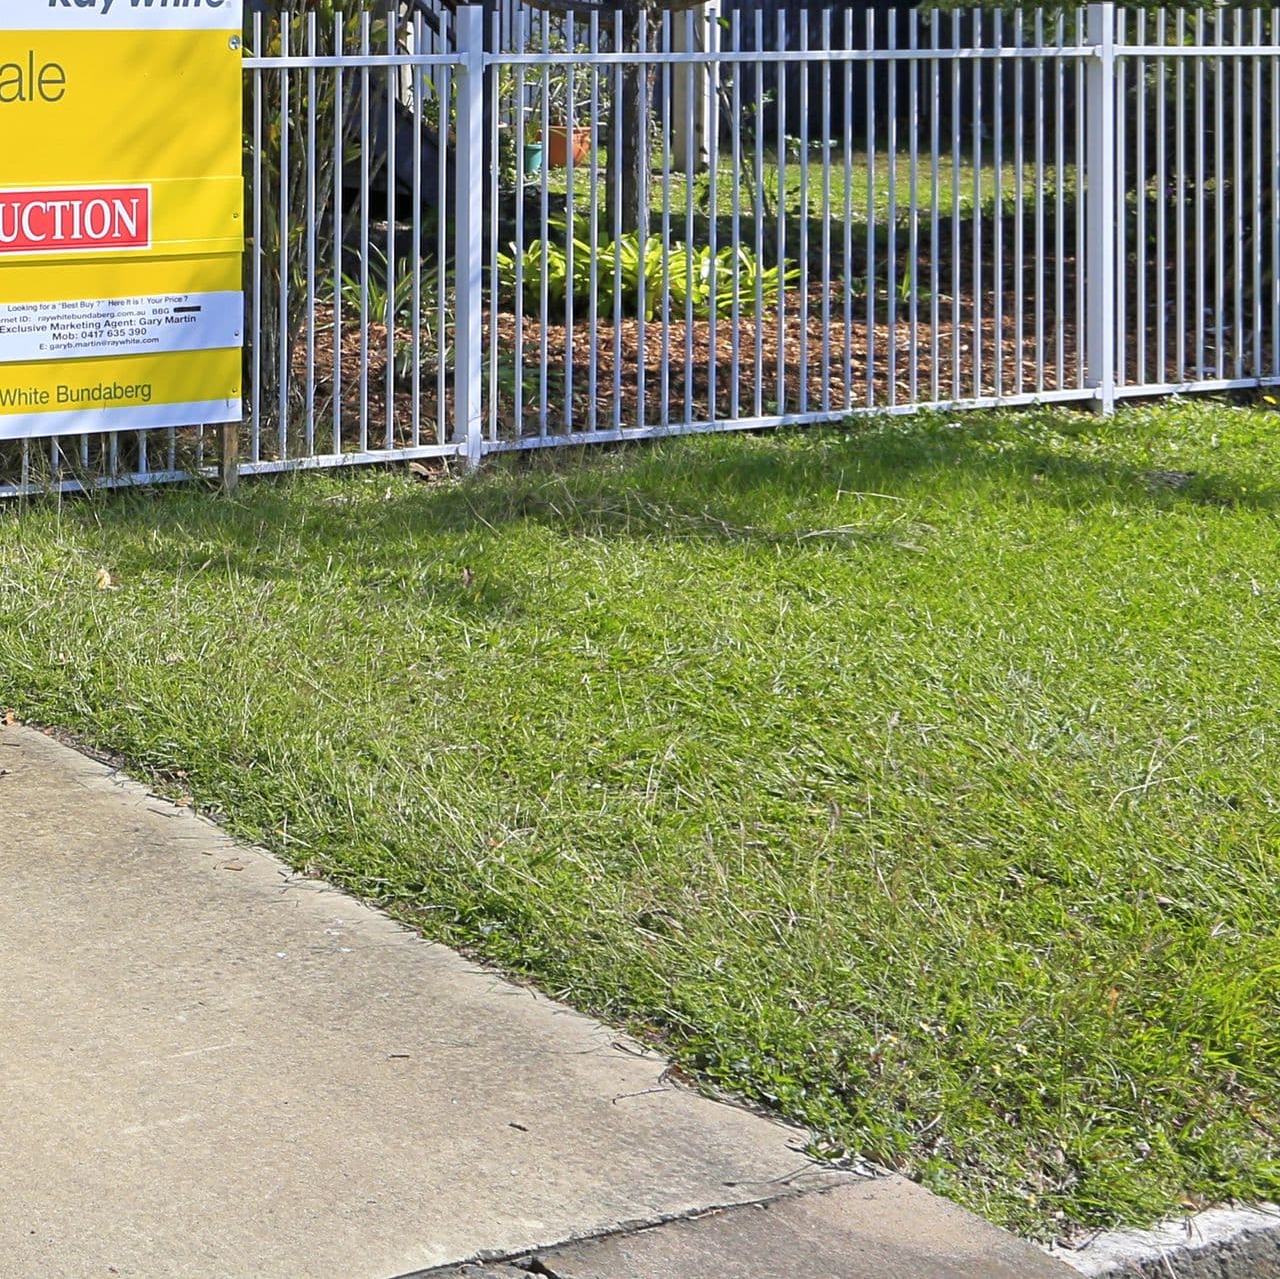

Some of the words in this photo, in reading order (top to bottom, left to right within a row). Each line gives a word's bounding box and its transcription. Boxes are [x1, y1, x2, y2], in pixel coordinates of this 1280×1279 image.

[7, 304, 38, 312] Looking
[39, 303, 50, 311] for
[80, 300, 94, 309] Buy
[108, 299, 125, 307] Here
[146, 296, 163, 305] Your
[164, 295, 183, 304] Price
[0, 323, 48, 334] Exclusive
[50, 320, 101, 331] Marketing
[103, 318, 137, 329] Agent:
[139, 317, 162, 327] Gary
[165, 314, 197, 324] Martin
[19, 315, 32, 323] ID:
[37, 310, 146, 323] raywhitebundaberg.com.au
[52, 331, 78, 341] Mob:
[81, 329, 104, 339] 0417
[107, 328, 126, 338] 635
[128, 327, 147, 336] 390
[39, 343, 47, 351] E:
[0, 387, 50, 407] White
[56, 382, 152, 403] Bundaberg
